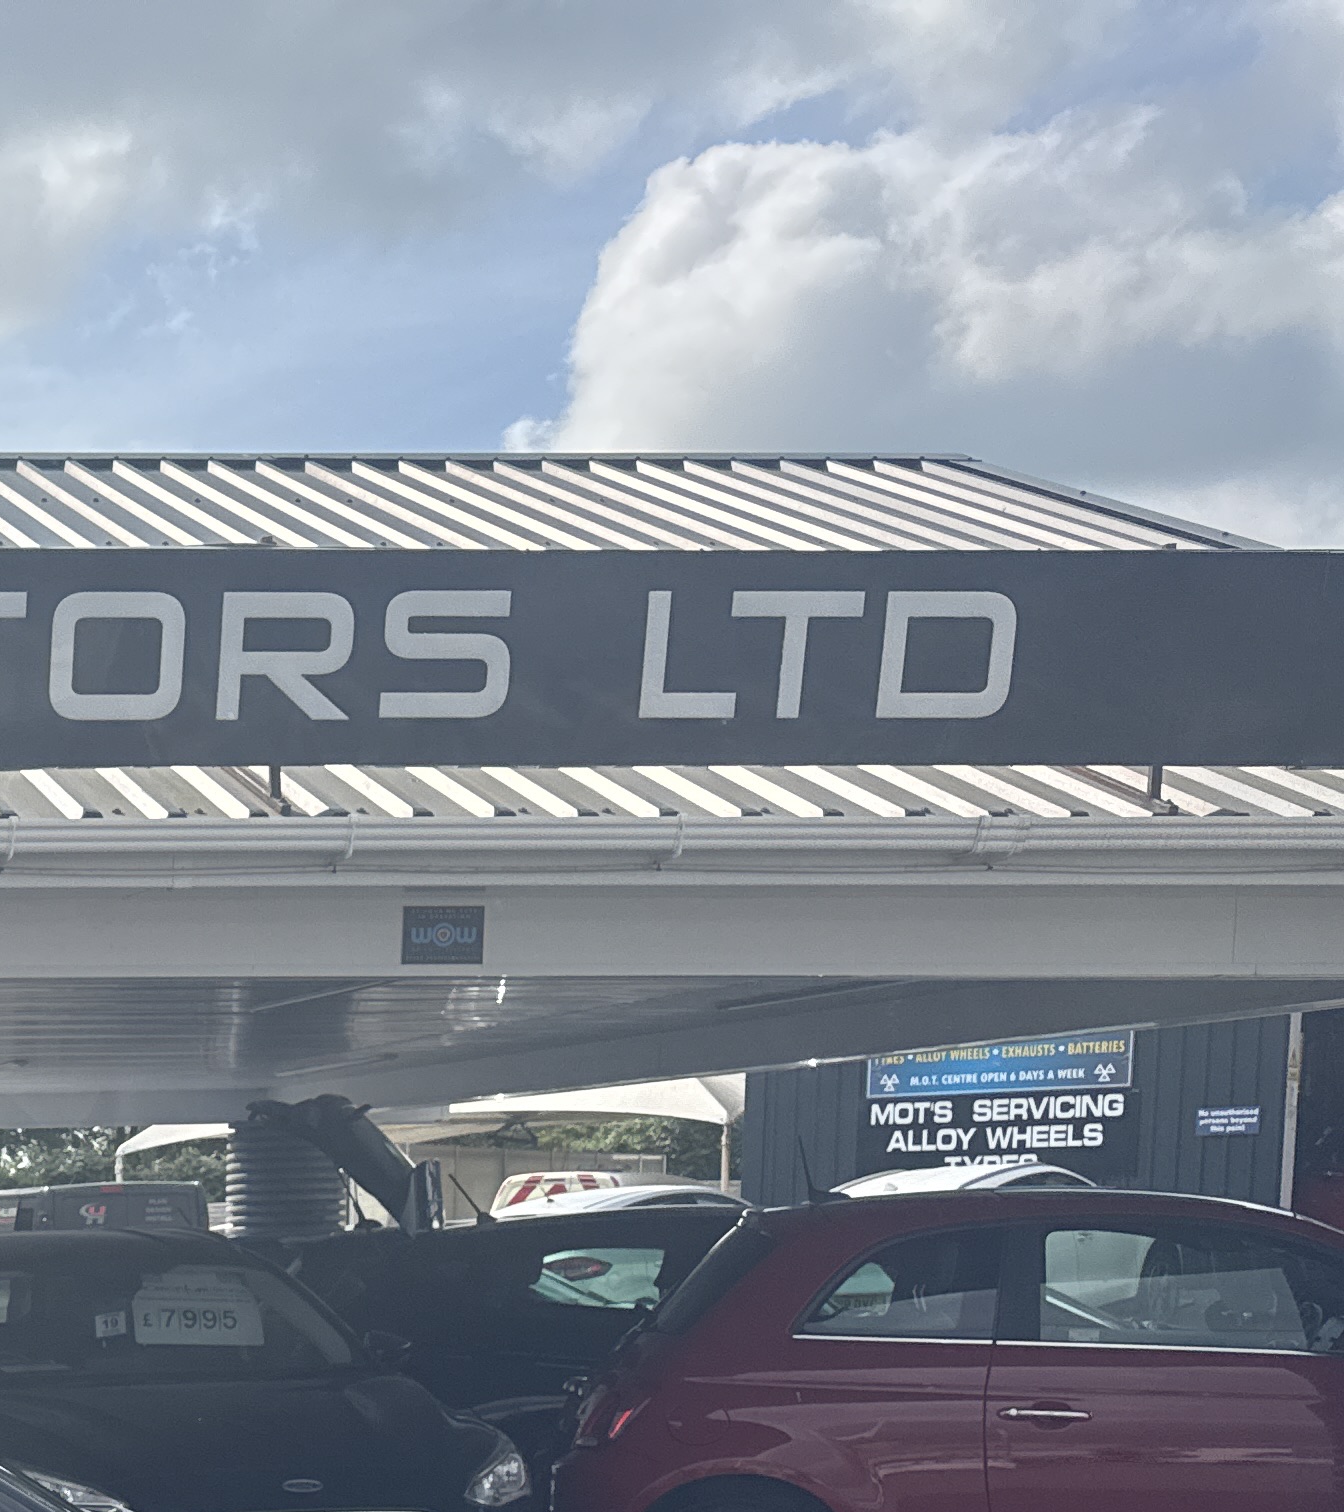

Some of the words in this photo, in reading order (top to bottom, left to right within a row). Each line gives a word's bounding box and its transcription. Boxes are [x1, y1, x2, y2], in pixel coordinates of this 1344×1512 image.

[638, 589, 1018, 719] LTD
[915, 1051, 947, 1063] ALLOY
[950, 1047, 991, 1061] WHEELS
[1001, 1043, 1056, 1058] EXHAUSTS
[1067, 1039, 1126, 1055] BATTERIES
[909, 1074, 939, 1086] M.O.T.
[942, 1072, 978, 1085] CENTRE
[980, 1070, 1008, 1083] OPEN
[1010, 1071, 1017, 1082] 6
[1018, 1069, 1045, 1082] DAYS
[1046, 1069, 1055, 1080] A
[1057, 1067, 1086, 1080] WEEK
[870, 1100, 953, 1126] MOT'S
[972, 1093, 1125, 1122] SERVICING
[886, 1128, 977, 1153] ALLOY
[985, 1123, 1104, 1150] WHEELS
